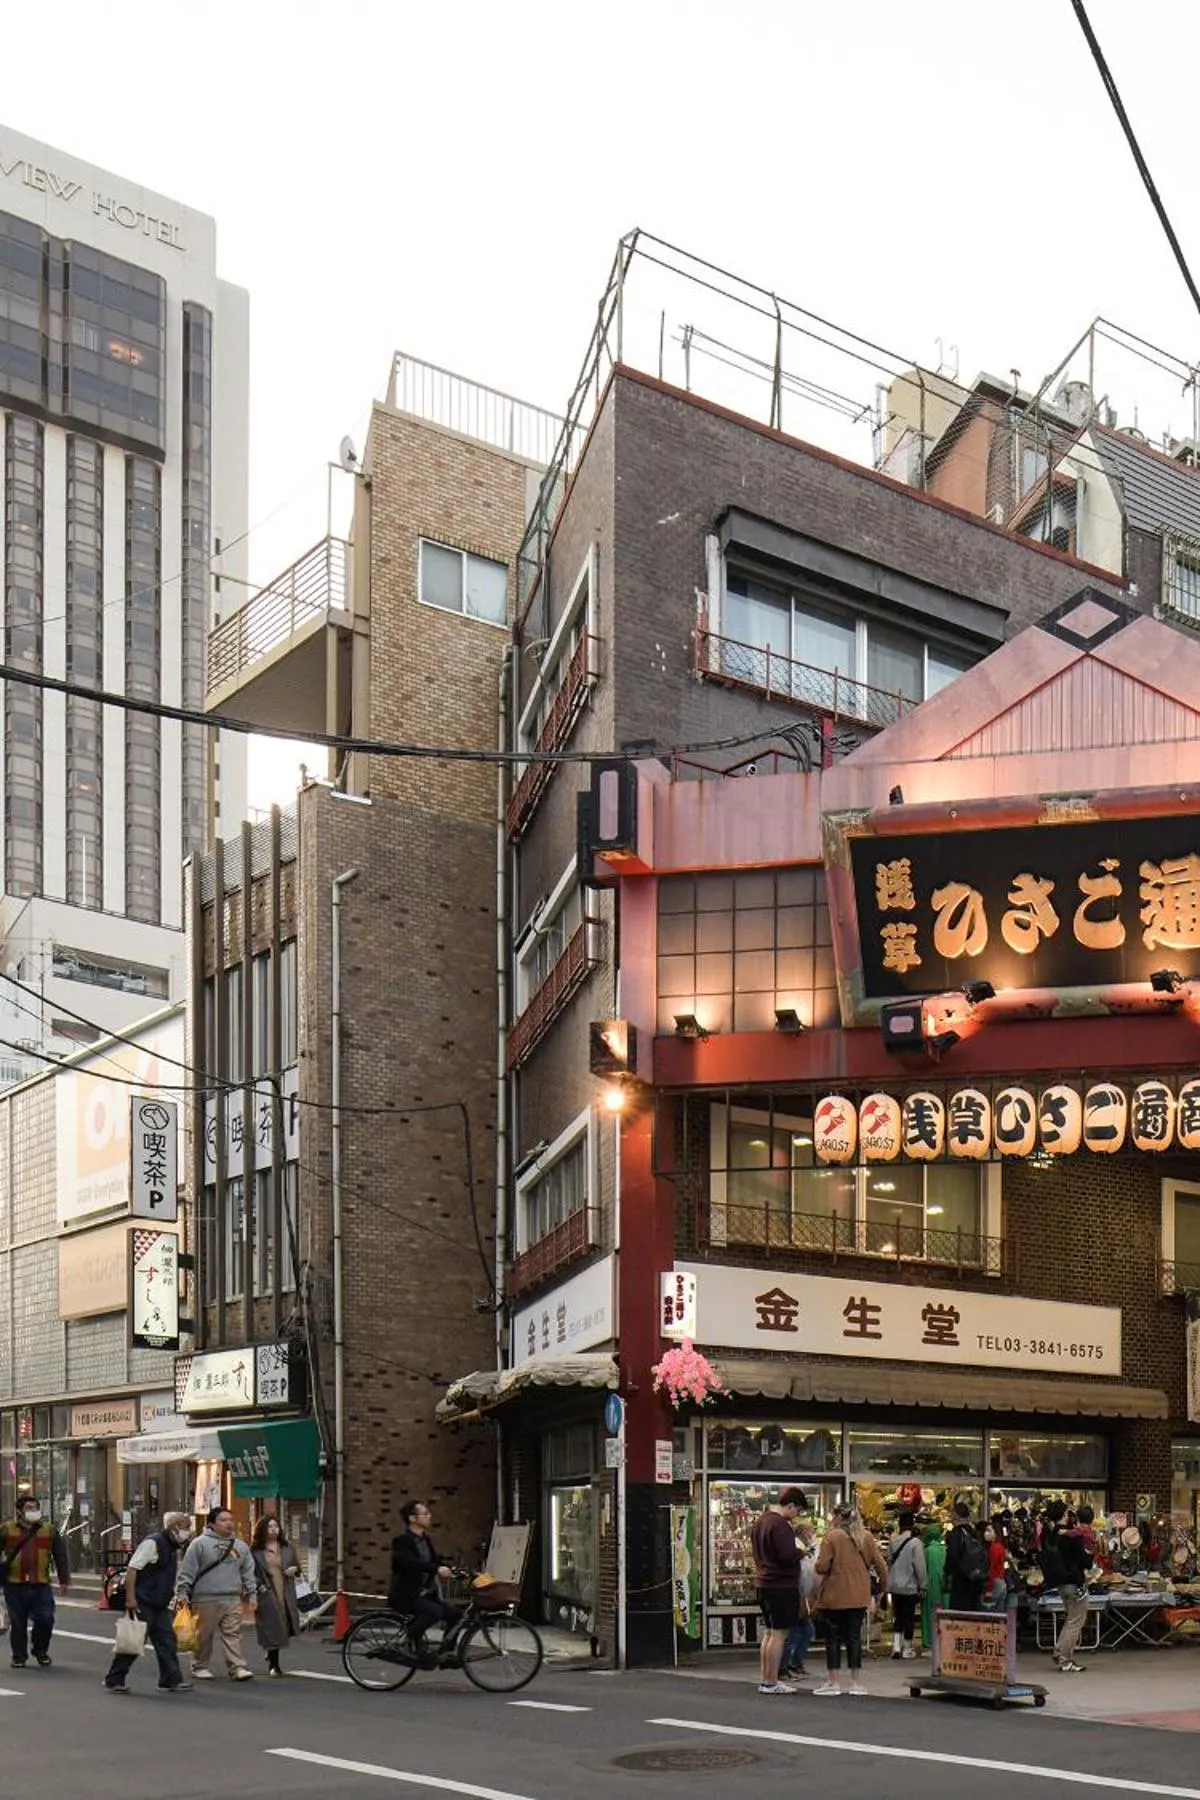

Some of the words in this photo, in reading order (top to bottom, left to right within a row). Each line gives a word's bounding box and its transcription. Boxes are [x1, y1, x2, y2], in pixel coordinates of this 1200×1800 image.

[0, 160, 82, 201] VIEW
[93, 191, 187, 251] HOTEL
[143, 1132, 168, 1208] 喫茶P
[755, 1287, 960, 1347] 金生堂
